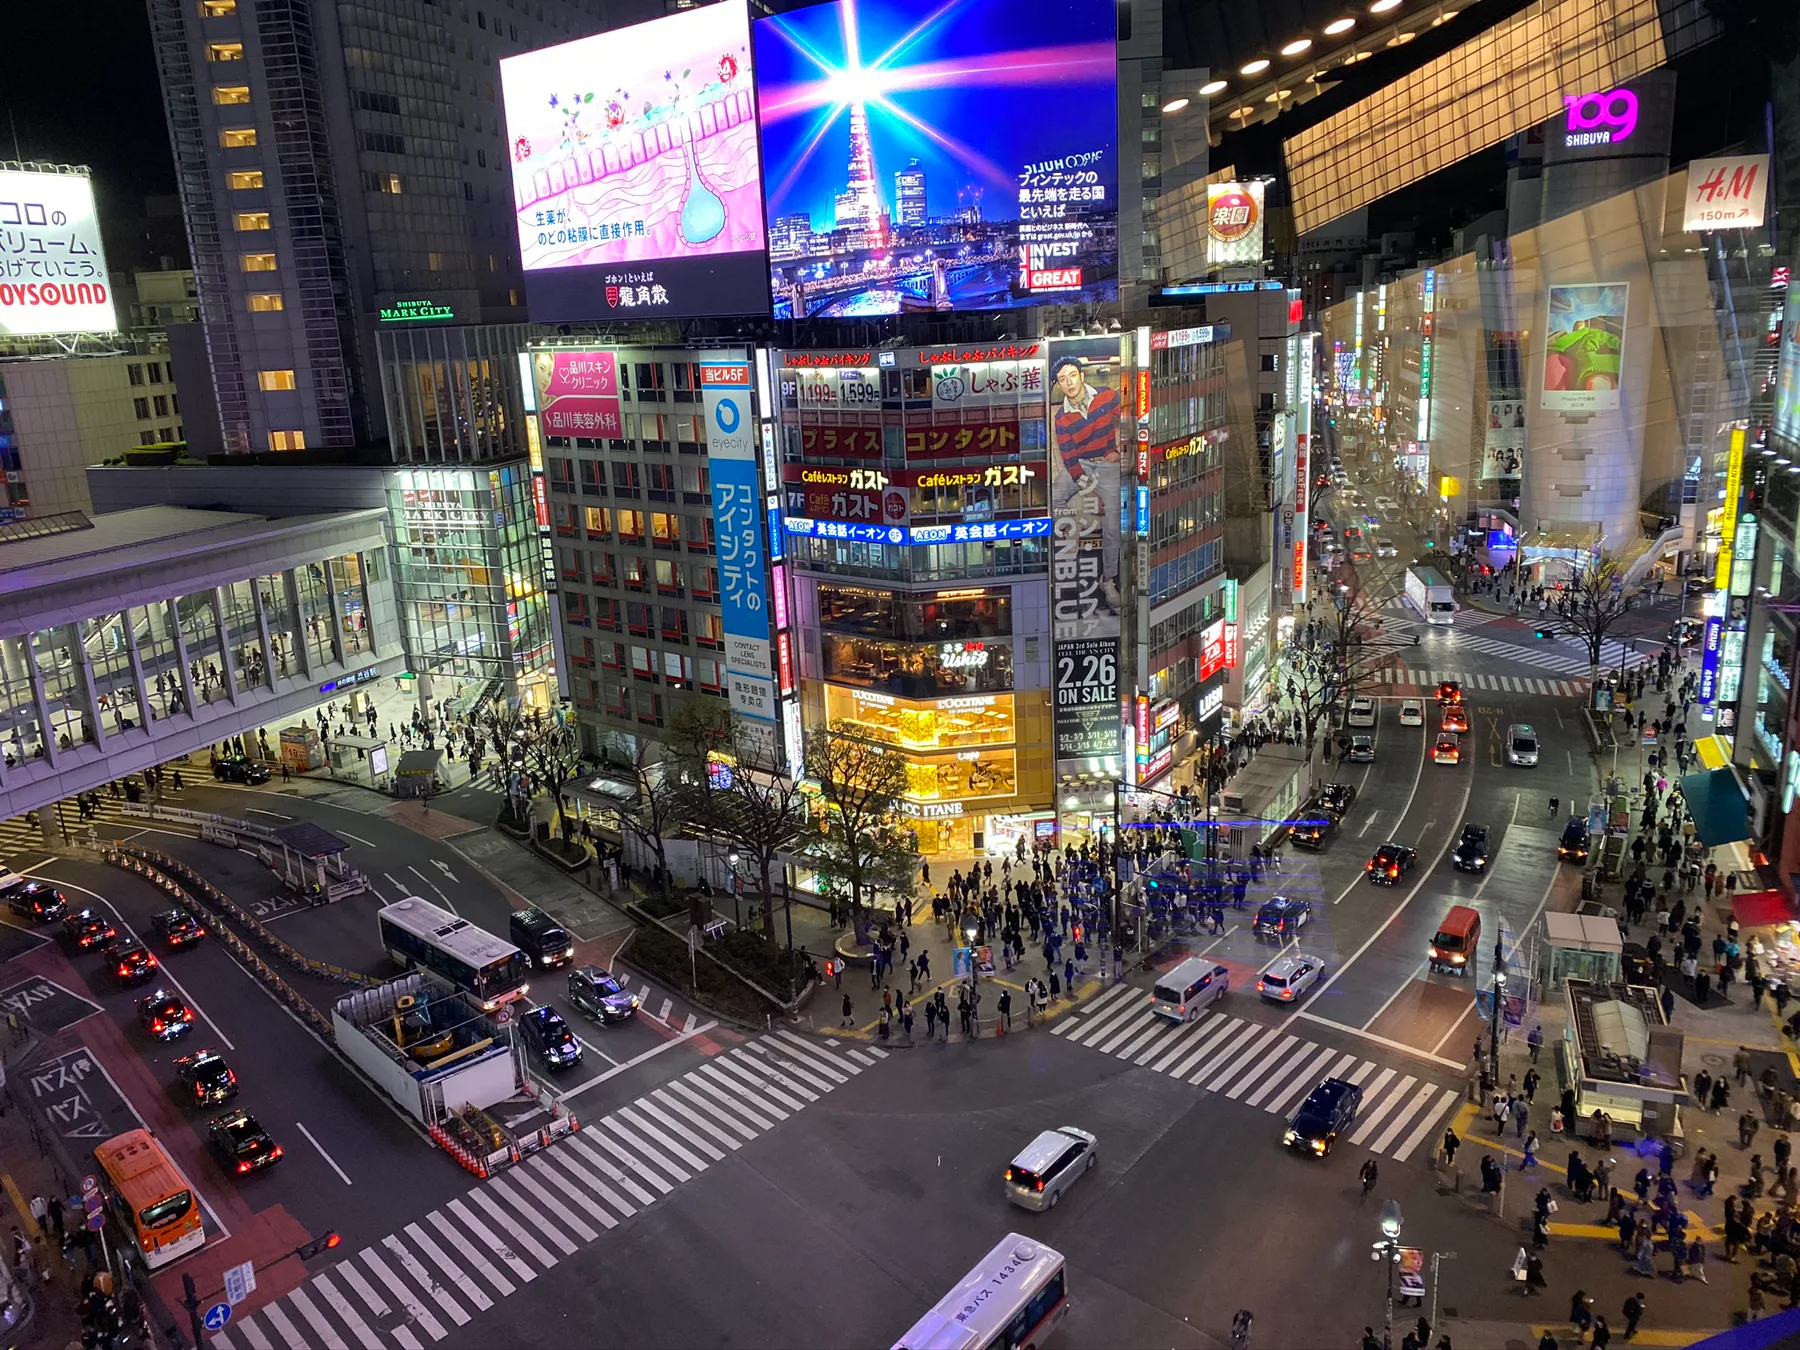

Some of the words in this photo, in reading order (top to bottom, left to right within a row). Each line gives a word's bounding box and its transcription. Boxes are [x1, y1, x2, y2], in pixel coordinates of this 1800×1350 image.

[1565, 89, 1638, 142] 109
[1565, 132, 1610, 147] SHIBUYA
[1020, 171, 1097, 186] フィンテックの
[1696, 164, 1759, 203] H&M
[1019, 185, 1105, 203] 最先端を走る国
[535, 210, 571, 227] 生薬が、
[1020, 204, 1066, 219] といえば
[1213, 206, 1250, 226] 楽園
[1700, 211, 1735, 222] 150m
[538, 220, 652, 246] のどの粘膜に直接作用。
[1030, 242, 1079, 257] INVEST
[1030, 257, 1044, 270] IN
[1032, 270, 1079, 286] GREAT
[619, 285, 669, 307] 龍角散
[380, 309, 417, 318] MARK
[420, 307, 451, 316] CITY
[784, 352, 871, 367] しゃぶしゃぶバイキング
[919, 344, 1040, 364] しゃぶしゃぶバイキング
[570, 360, 611, 375] 品川スキン
[705, 368, 744, 382] 当ビル5F
[571, 376, 608, 390] クリニック
[781, 381, 796, 395] 9F
[971, 366, 1040, 394] しゃぶ葉
[553, 412, 617, 431] 品川美容外科
[712, 437, 748, 451] eyecity
[803, 430, 880, 451] プライス
[906, 426, 1016, 452] コンタクト
[1189, 435, 1208, 456] ガスト
[1139, 451, 1147, 476] ガスト
[802, 470, 848, 484] Caféレストラン
[850, 469, 889, 491] ガスト
[917, 473, 981, 488] Caféレストラン
[984, 465, 1035, 487] ガスト
[788, 492, 805, 508] 7F
[809, 493, 829, 505] Café
[831, 491, 878, 519] ガスト
[1053, 508, 1077, 516] from
[816, 522, 886, 540] 英会話イーオン
[916, 529, 948, 541] AEON
[954, 521, 1049, 540] 英会話イーオン
[716, 482, 743, 609] アイシティ
[739, 484, 762, 612] コンタクトの
[1078, 472, 1100, 637] ジョン・ヨンファ
[1054, 517, 1079, 639] CNBLUE
[1708, 623, 1719, 651] MIZUHO
[734, 641, 760, 652] CONTACT
[740, 651, 755, 659] LENS
[1058, 643, 1075, 651] JAPAN
[730, 656, 767, 669] SPECIALISTS
[1058, 654, 1116, 689] 2.26
[734, 682, 767, 698] 隐形眼镜
[1058, 688, 1078, 705] ON
[1082, 685, 1116, 703] SALE
[740, 694, 764, 709] 专卖店
[1199, 685, 1223, 716] LUSH
[955, 1289, 993, 1323] 東急バス
[992, 1259, 1022, 1285] 1434
